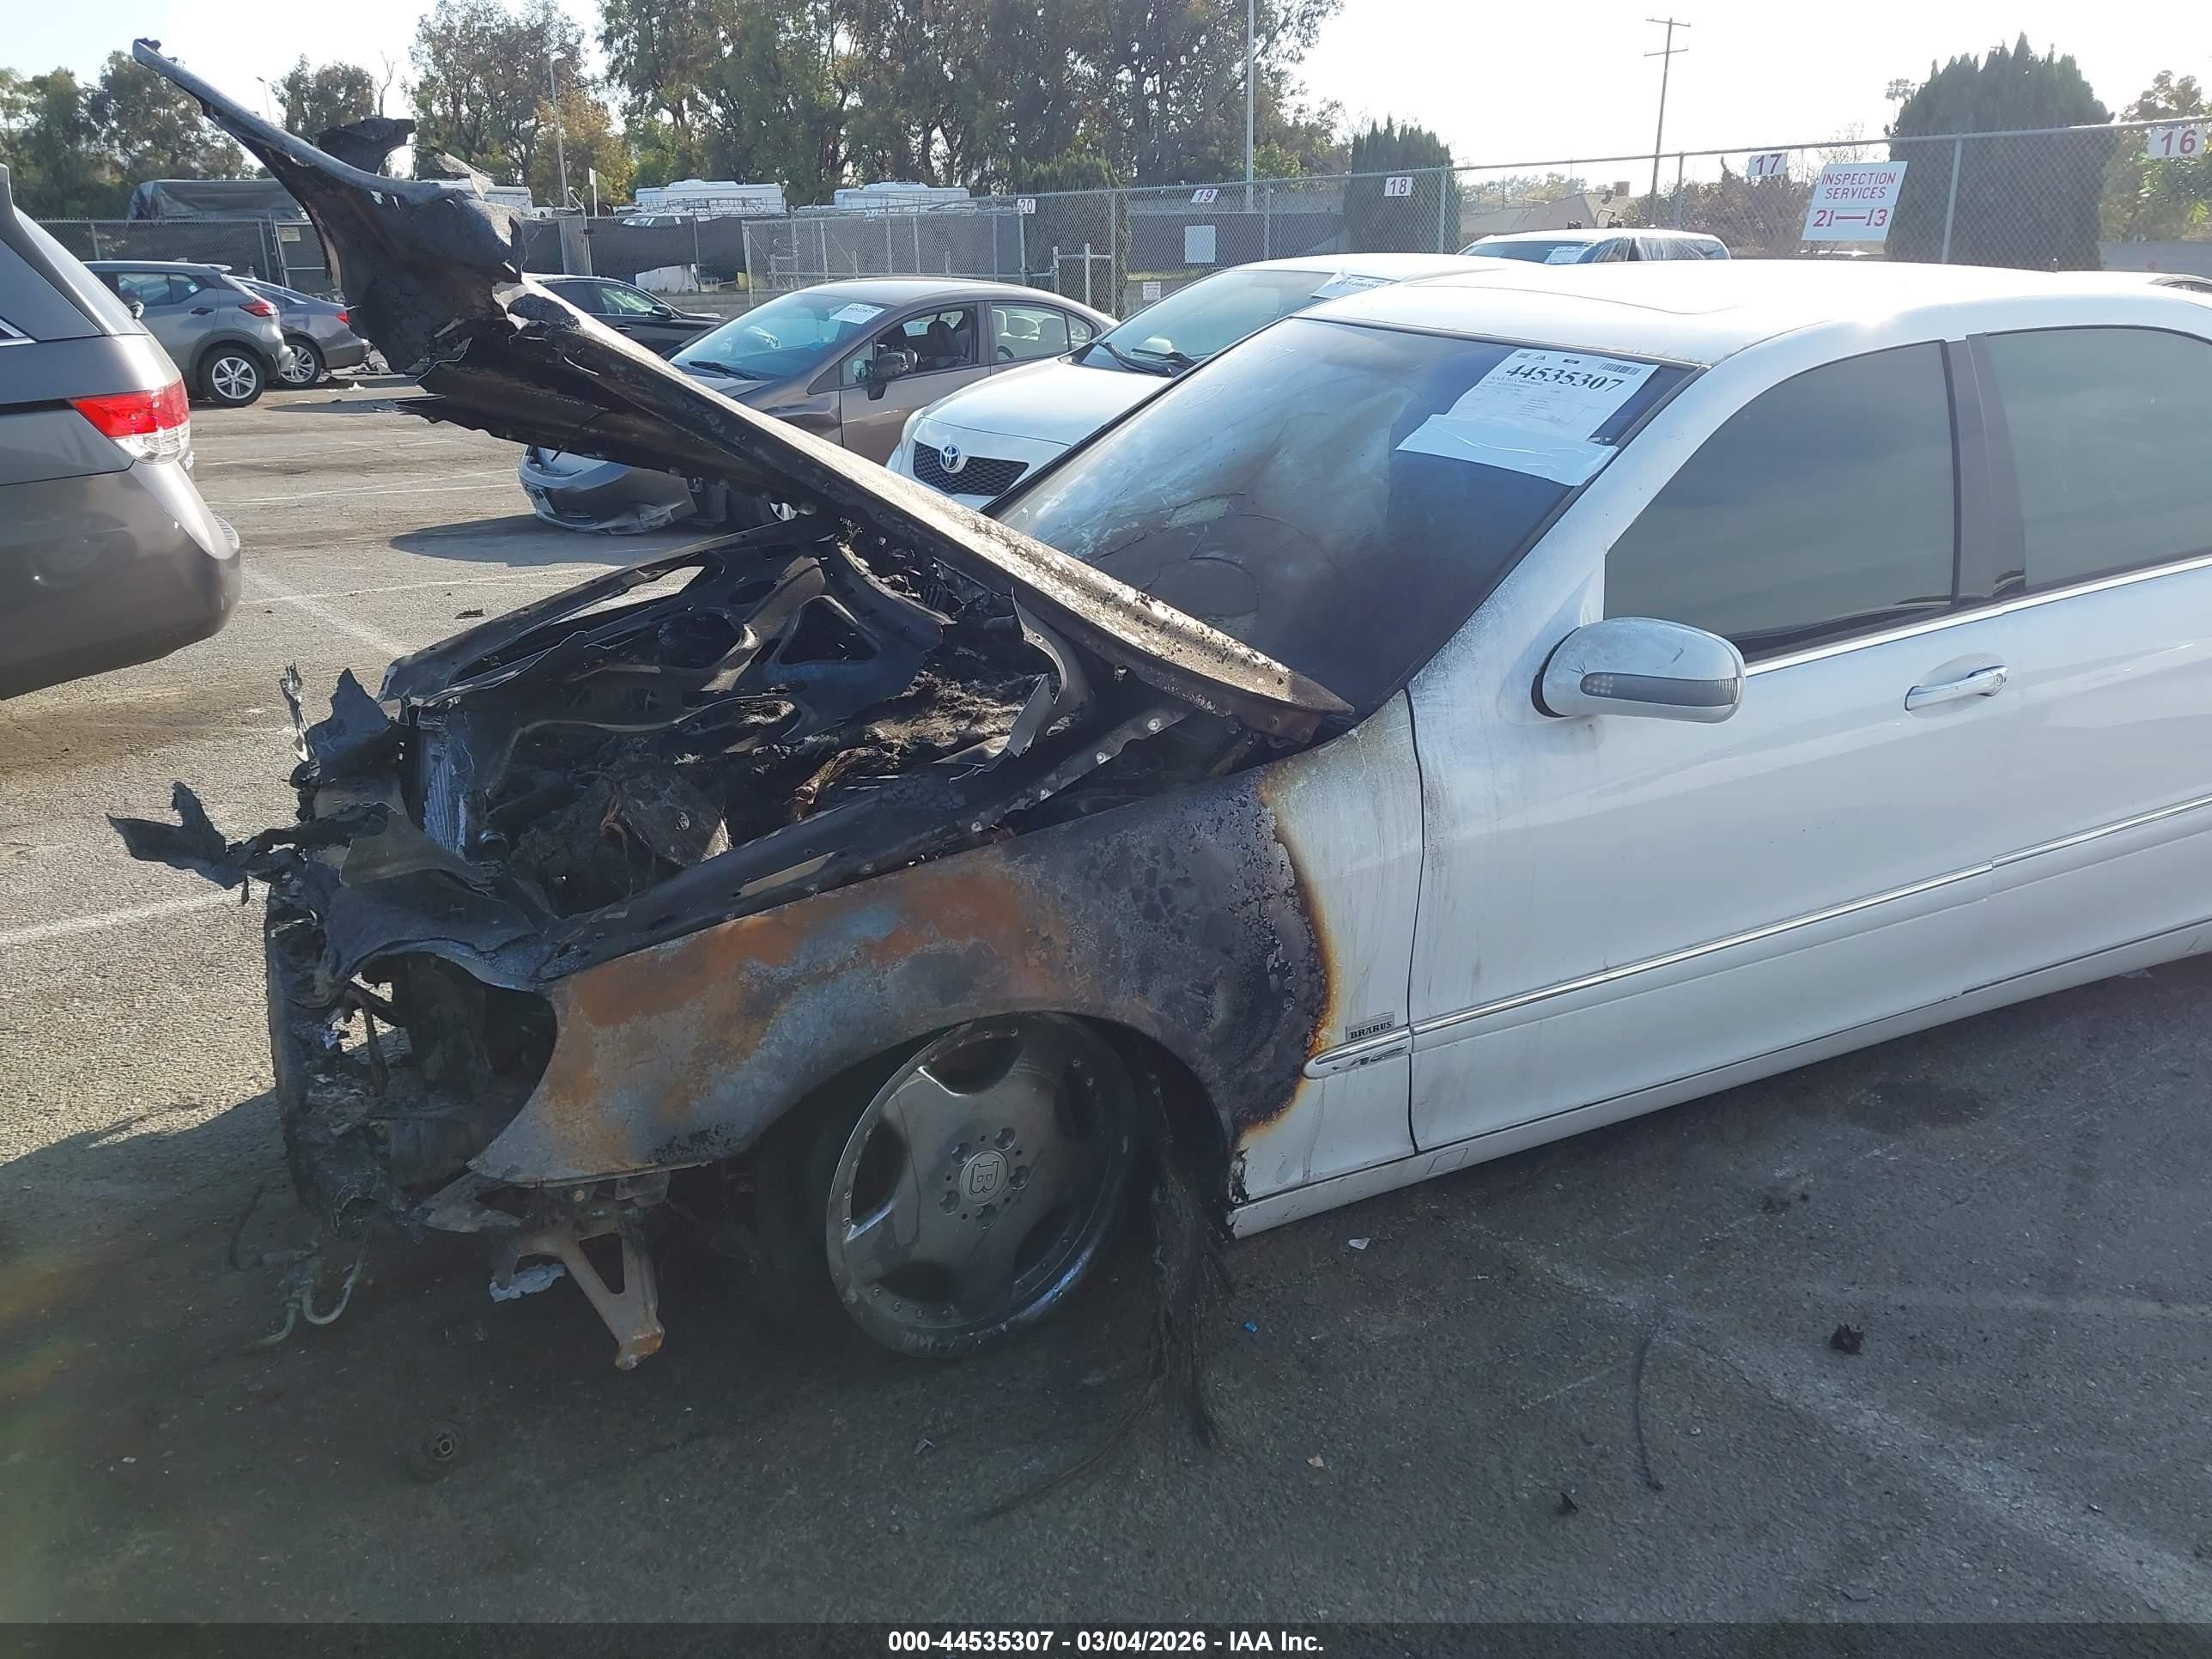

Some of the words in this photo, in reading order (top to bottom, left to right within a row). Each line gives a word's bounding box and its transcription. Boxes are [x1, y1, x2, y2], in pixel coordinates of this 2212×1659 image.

[2160, 129, 2197, 156] 16
[1755, 153, 1783, 175] 17
[1391, 178, 1407, 195] 18
[1820, 172, 1897, 186] INSPECTION
[1197, 190, 1213, 203] 19
[1824, 186, 1887, 200] SERVICES
[1019, 199, 1033, 213] 20
[1505, 364, 1626, 392] 44535307
[1350, 1021, 1393, 1039] BRABUS
